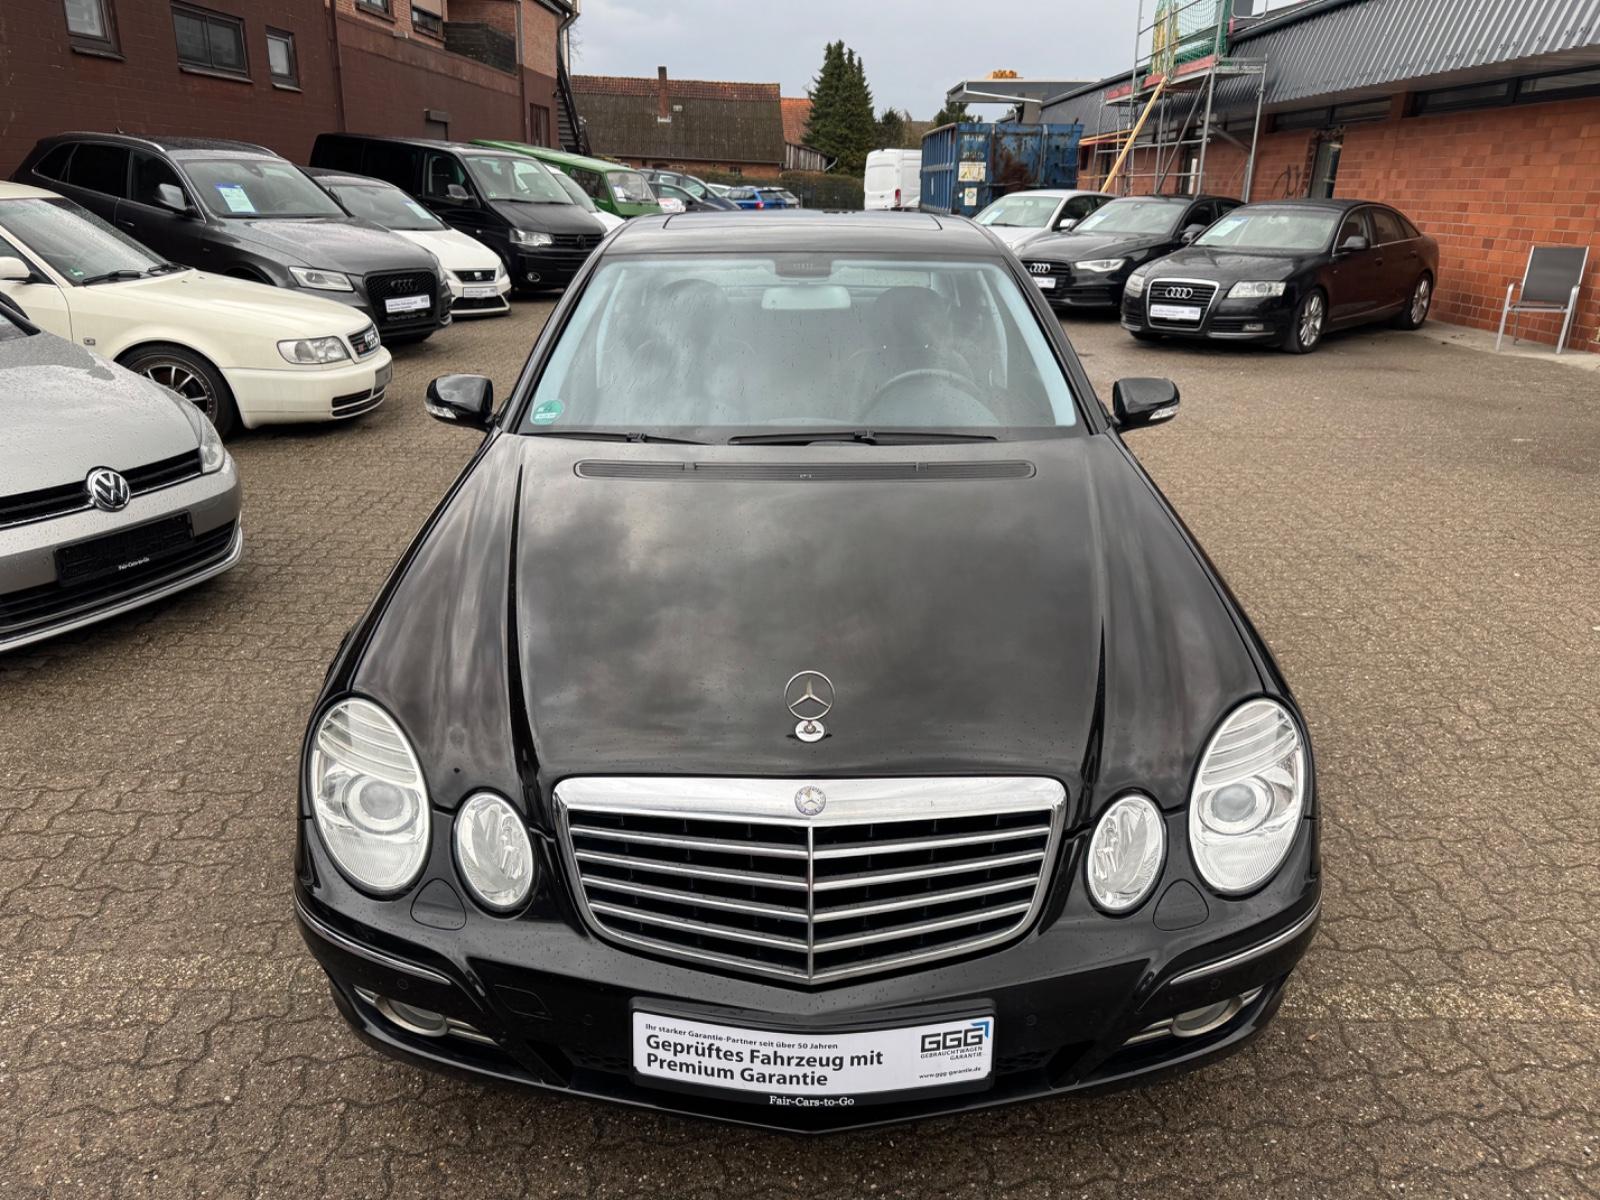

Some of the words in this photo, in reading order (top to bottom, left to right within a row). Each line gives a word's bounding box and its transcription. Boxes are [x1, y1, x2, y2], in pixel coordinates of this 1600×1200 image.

[645, 1023, 657, 1031] Ihr
[658, 1026, 687, 1036] starker
[687, 1030, 757, 1047] Garantie-Partner
[759, 1040, 774, 1048] seit
[775, 1040, 796, 1049] über
[797, 1042, 808, 1050] 50
[809, 1042, 838, 1050] Jahren
[921, 1027, 983, 1053] GGG
[646, 1034, 744, 1063] Geprüftes
[749, 1049, 844, 1072] Fahrzeug
[849, 1050, 884, 1067] mit
[920, 1046, 983, 1060] GEBRAUCHTWAGEN
[949, 1052, 983, 1061] GARANTIE
[647, 1052, 735, 1081] Premium
[740, 1067, 828, 1086] Garantie
[769, 1095, 855, 1107] Fair-Cars-to-Go
